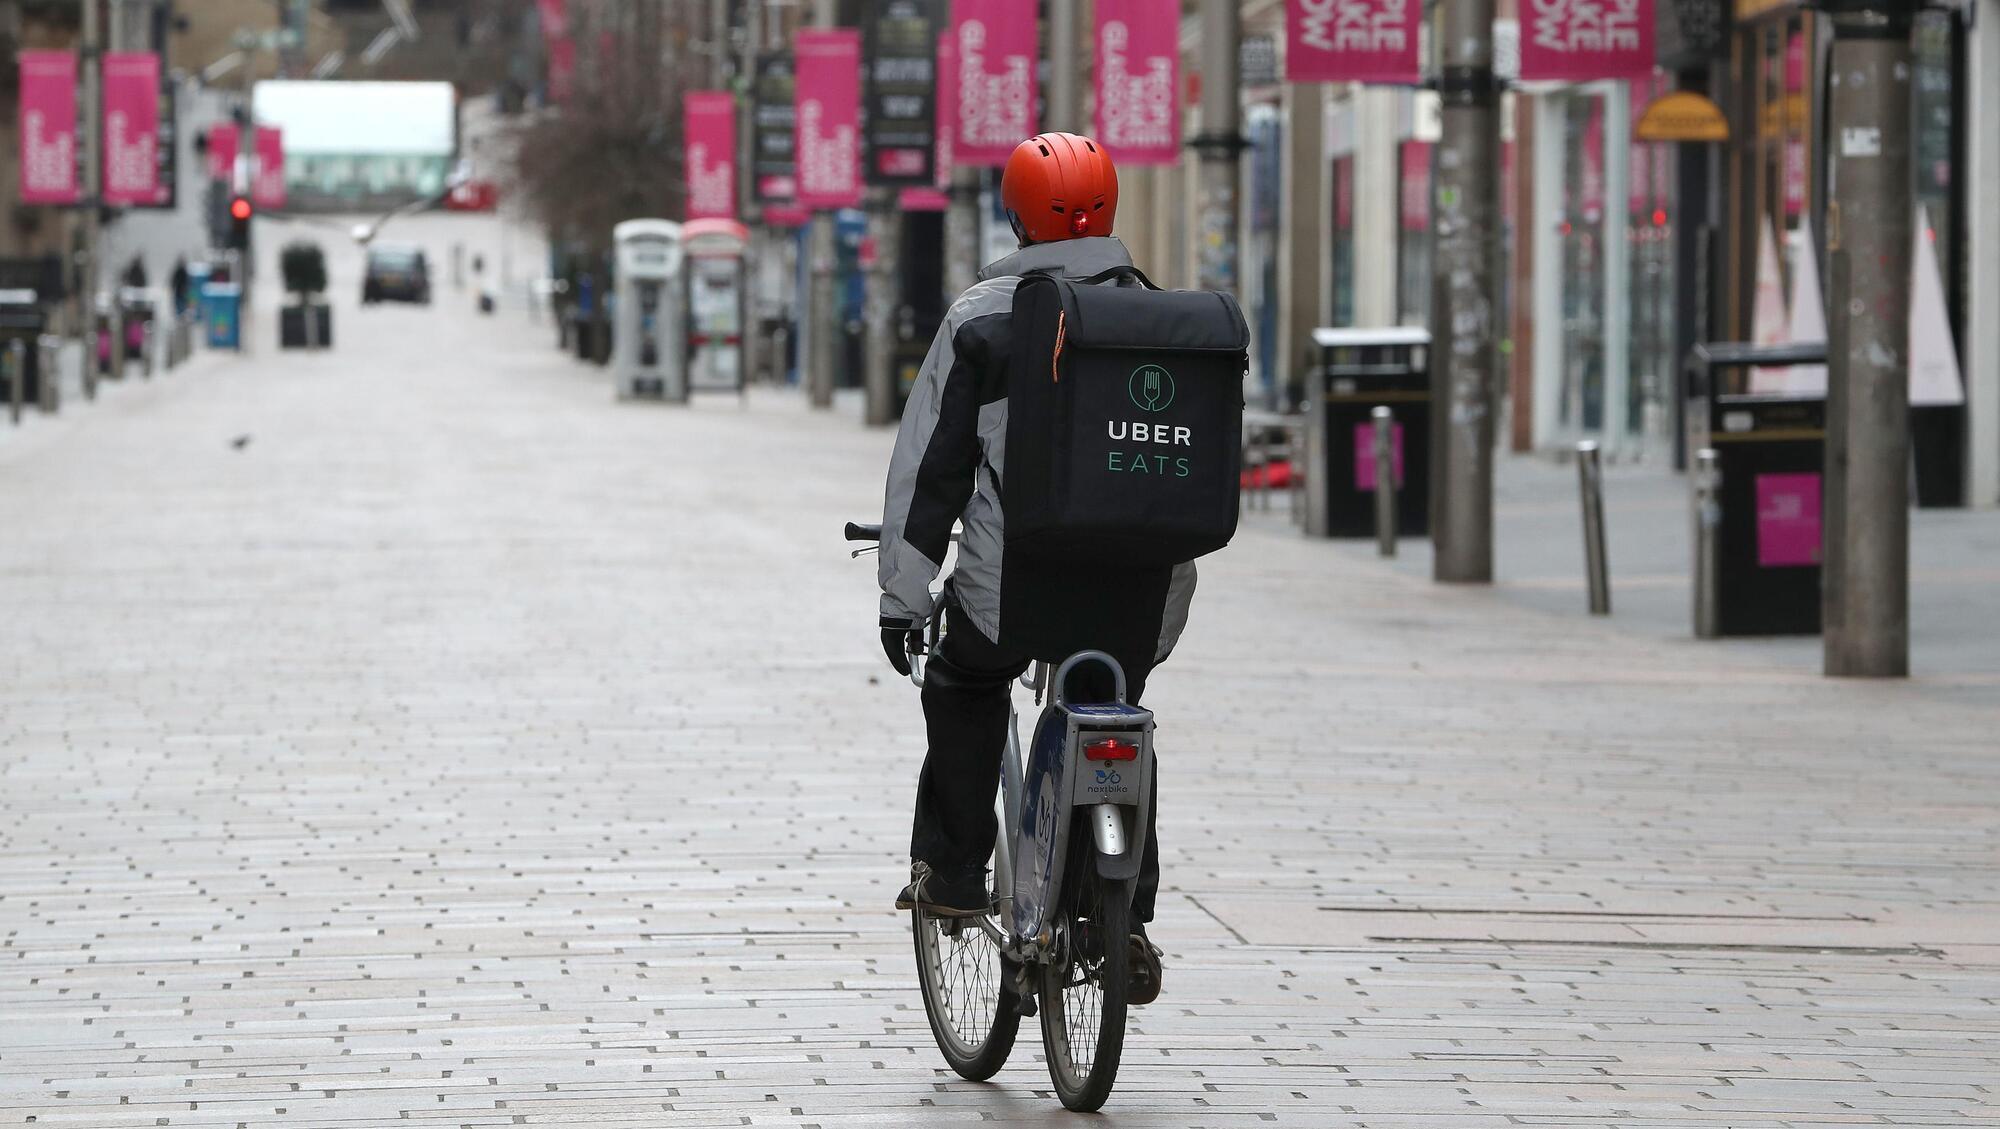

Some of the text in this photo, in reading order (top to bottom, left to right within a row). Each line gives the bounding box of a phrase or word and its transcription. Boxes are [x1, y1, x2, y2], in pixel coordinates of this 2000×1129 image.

[959, 19, 985, 145] GLASGOW
[1102, 20, 1128, 146] GLASGOW
[1147, 56, 1172, 147] PEOPLE
[1108, 420, 1191, 446] UBER
[1108, 451, 1189, 477] EATS
[1087, 784, 1128, 793] nextbike
